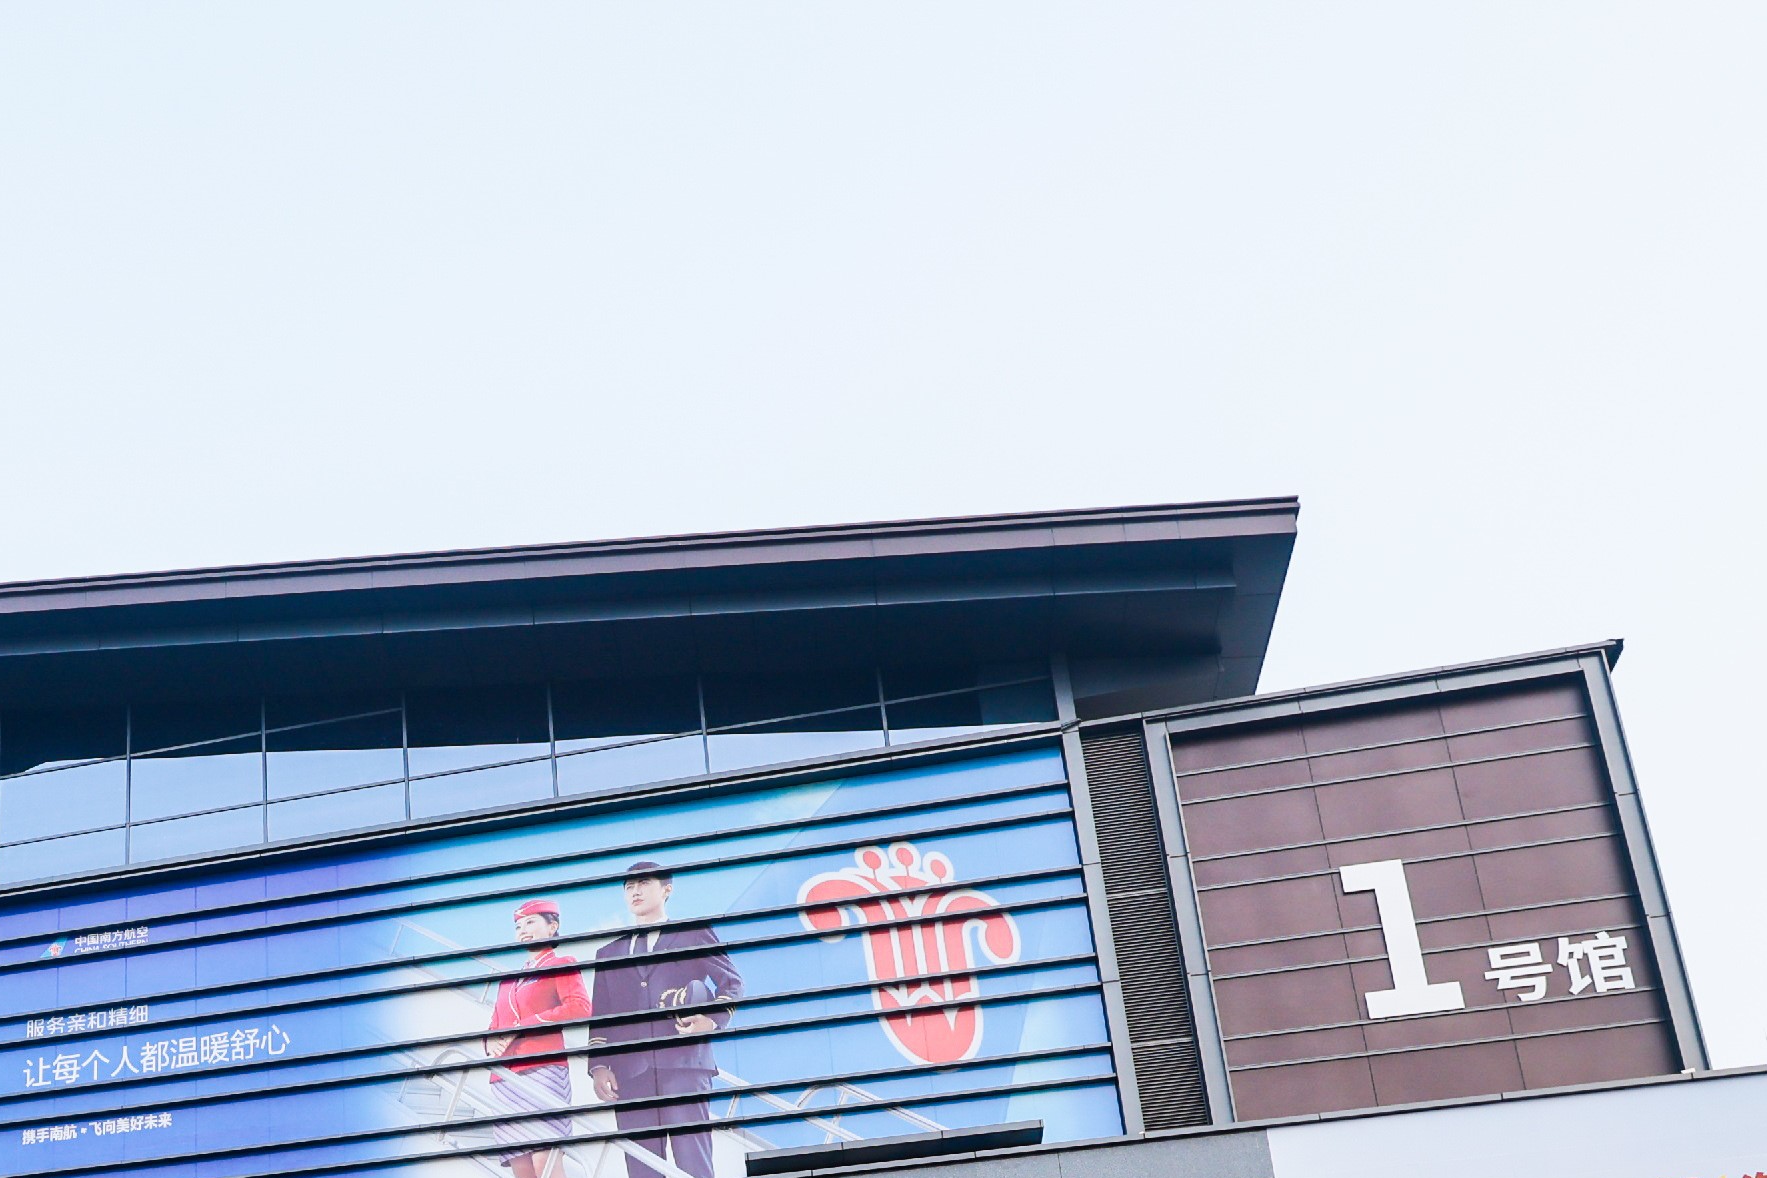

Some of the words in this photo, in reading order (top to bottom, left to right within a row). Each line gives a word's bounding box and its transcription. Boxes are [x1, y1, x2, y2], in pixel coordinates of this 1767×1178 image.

[75, 926, 149, 947] 中国南方航空
[26, 1005, 149, 1038] 服务亲和精细
[23, 1024, 291, 1087] 让每个人都温暖舒心
